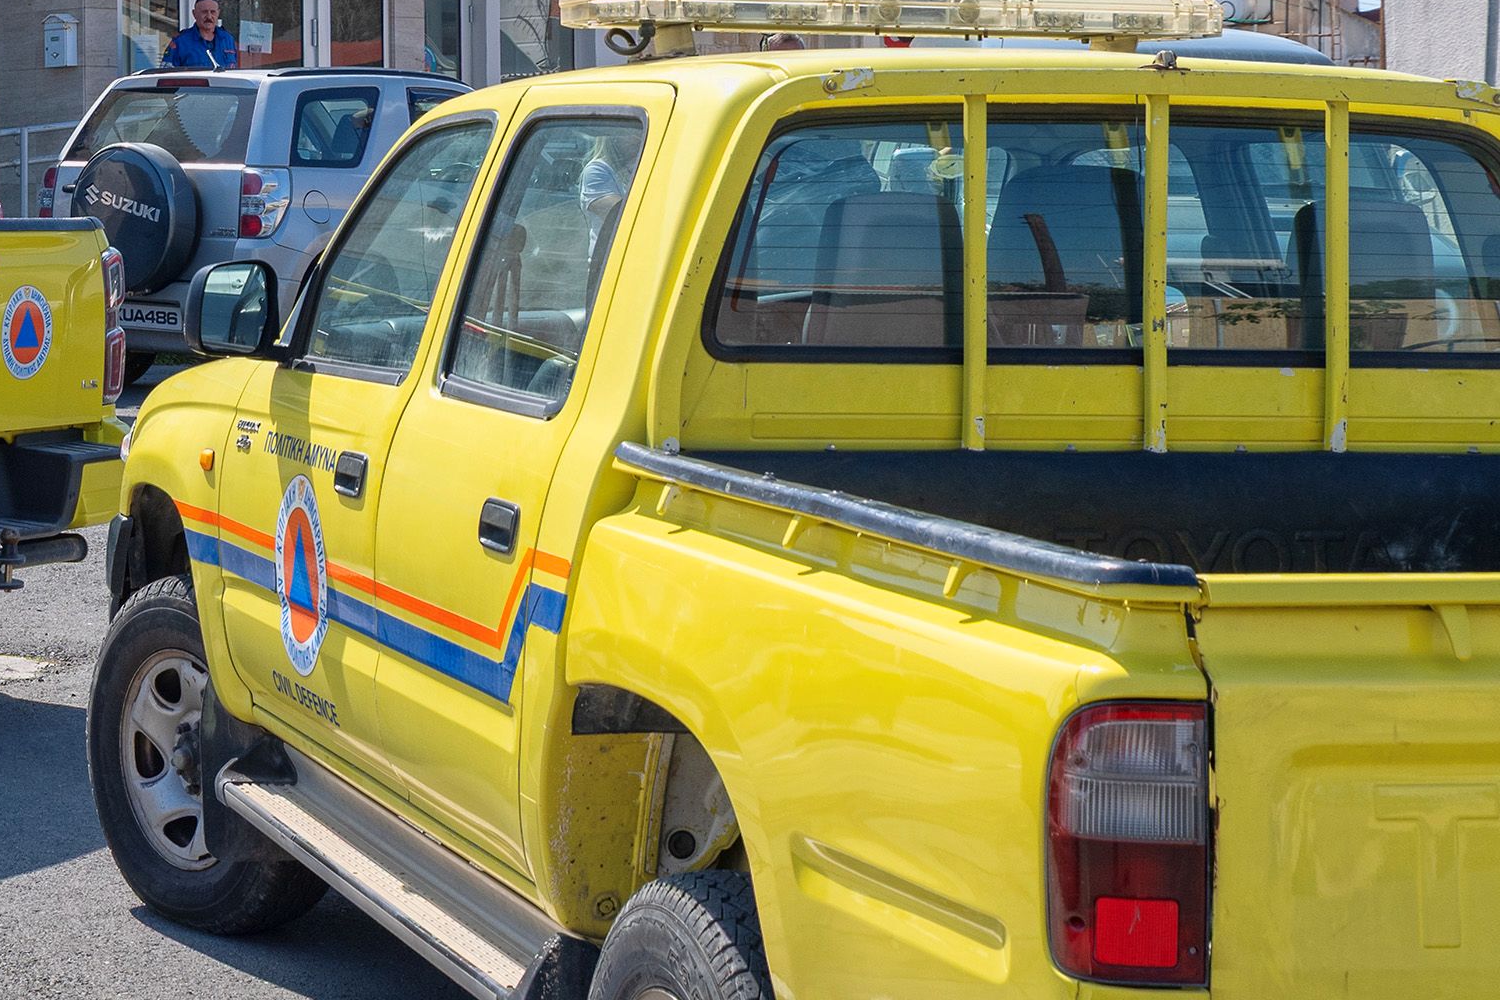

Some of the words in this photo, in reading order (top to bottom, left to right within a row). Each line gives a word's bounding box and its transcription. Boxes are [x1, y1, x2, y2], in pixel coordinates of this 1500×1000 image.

[101, 190, 161, 223] SUZUKI
[264, 431, 306, 462] ΠΟΛΙΤΙΚΗ
[303, 442, 337, 473] ΑΜΥΝΑ
[272, 669, 297, 701] CIVIL
[295, 682, 340, 727] DEFENCE
